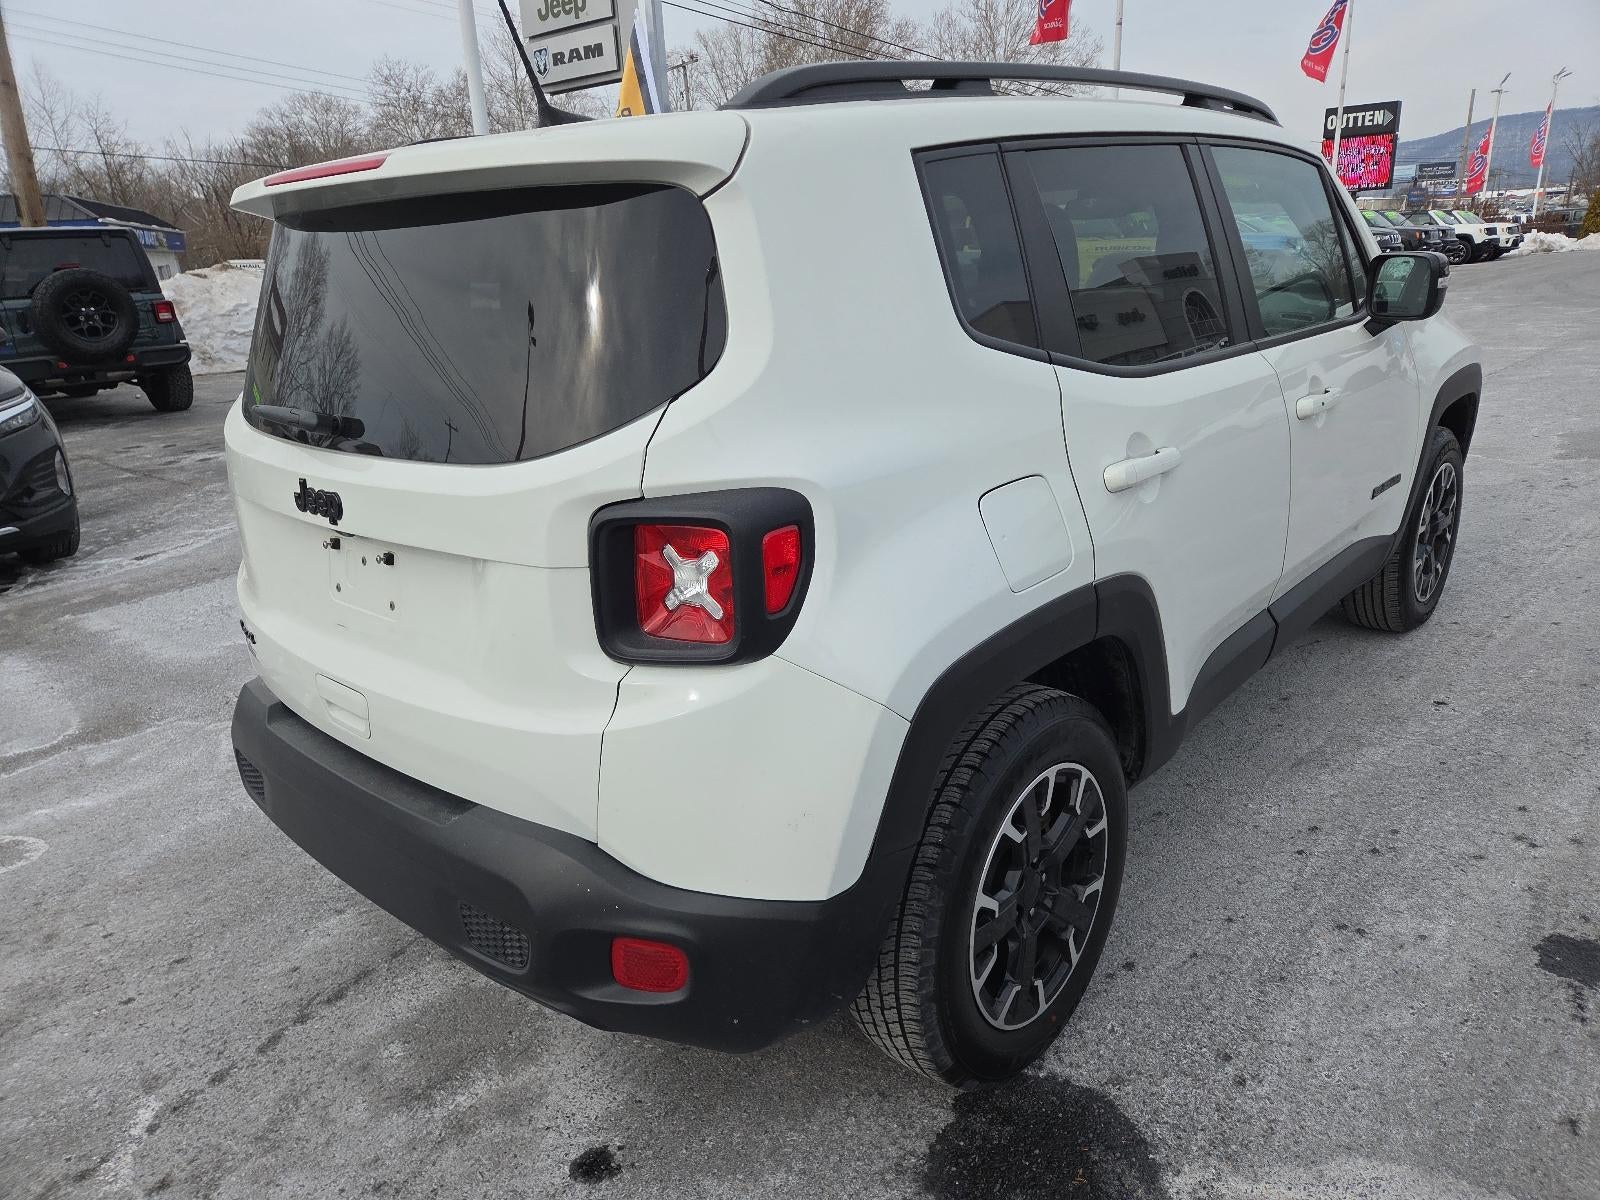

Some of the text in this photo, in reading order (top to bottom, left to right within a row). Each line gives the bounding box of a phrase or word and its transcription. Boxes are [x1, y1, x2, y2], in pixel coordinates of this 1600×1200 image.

[537, 0, 587, 21] Jeep
[552, 42, 604, 67] RAM
[293, 477, 344, 526] Jeep
